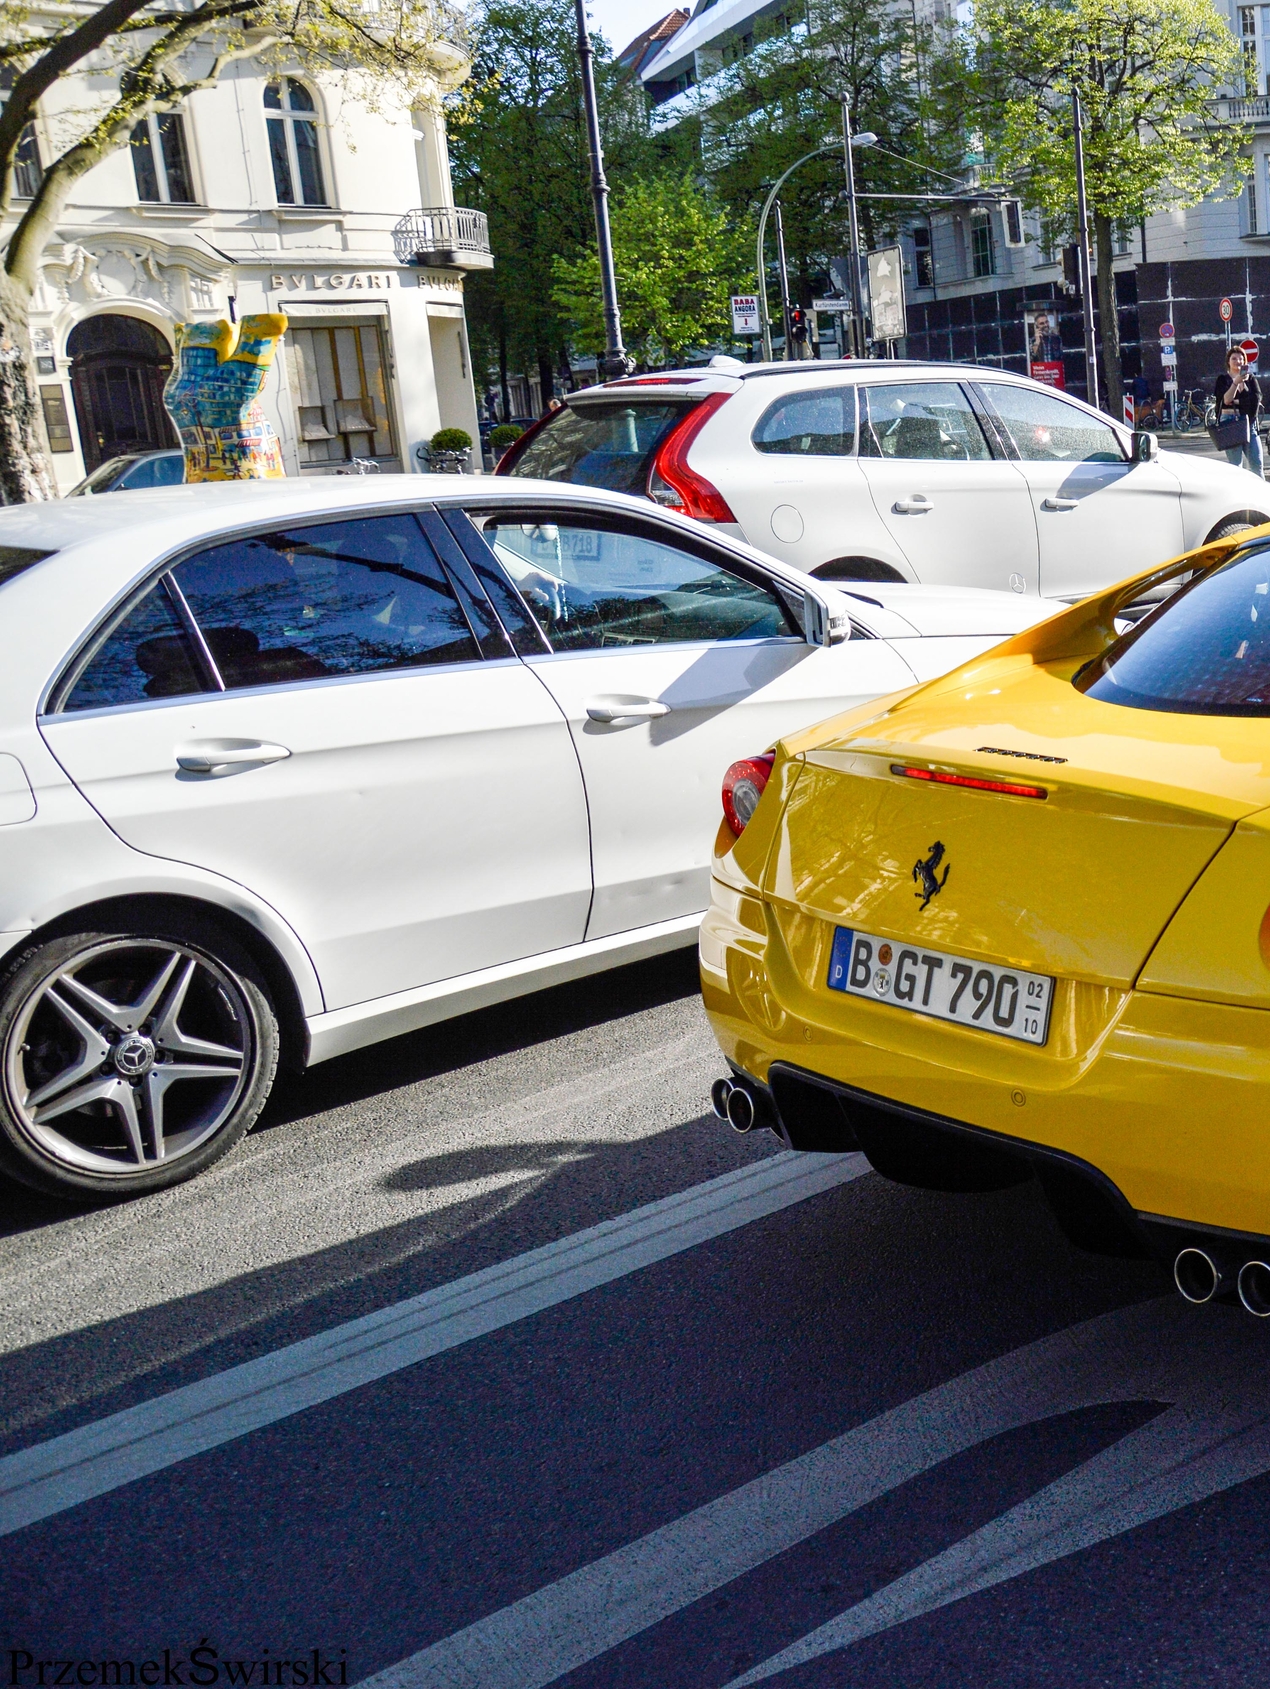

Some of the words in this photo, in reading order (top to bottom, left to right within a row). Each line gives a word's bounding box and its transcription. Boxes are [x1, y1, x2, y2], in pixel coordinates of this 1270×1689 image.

[271, 274, 392, 290] BVLGARI
[1222, 305, 1230, 315] 30
[835, 965, 843, 979] D
[850, 938, 873, 989] B
[893, 949, 943, 1007] GT
[949, 962, 1019, 1028] 790
[1027, 980, 1043, 999] 02
[1024, 1017, 1038, 1036] 10
